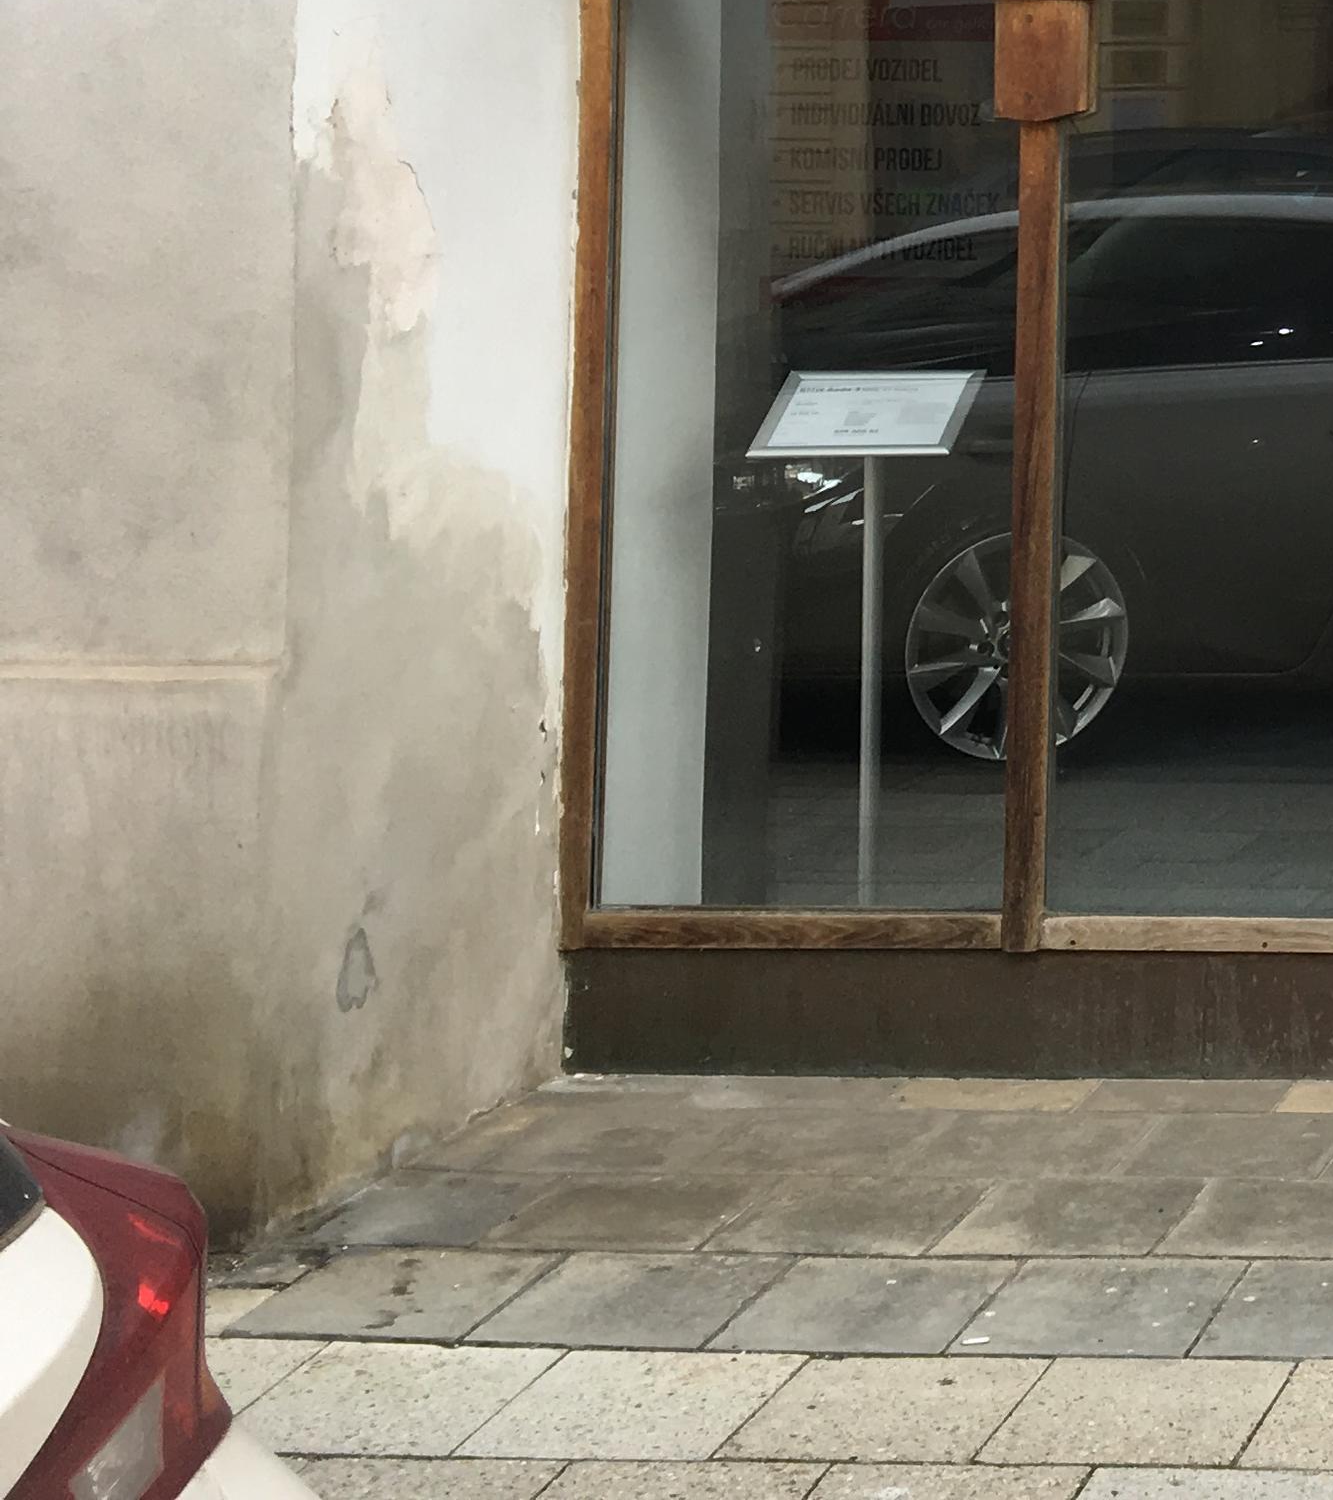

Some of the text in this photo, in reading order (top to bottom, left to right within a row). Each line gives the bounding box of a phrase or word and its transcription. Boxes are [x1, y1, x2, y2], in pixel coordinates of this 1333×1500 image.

[866, 58, 943, 82] VOZIDEL
[920, 103, 982, 127] DOVOZ
[873, 148, 943, 172] PRODEJ
